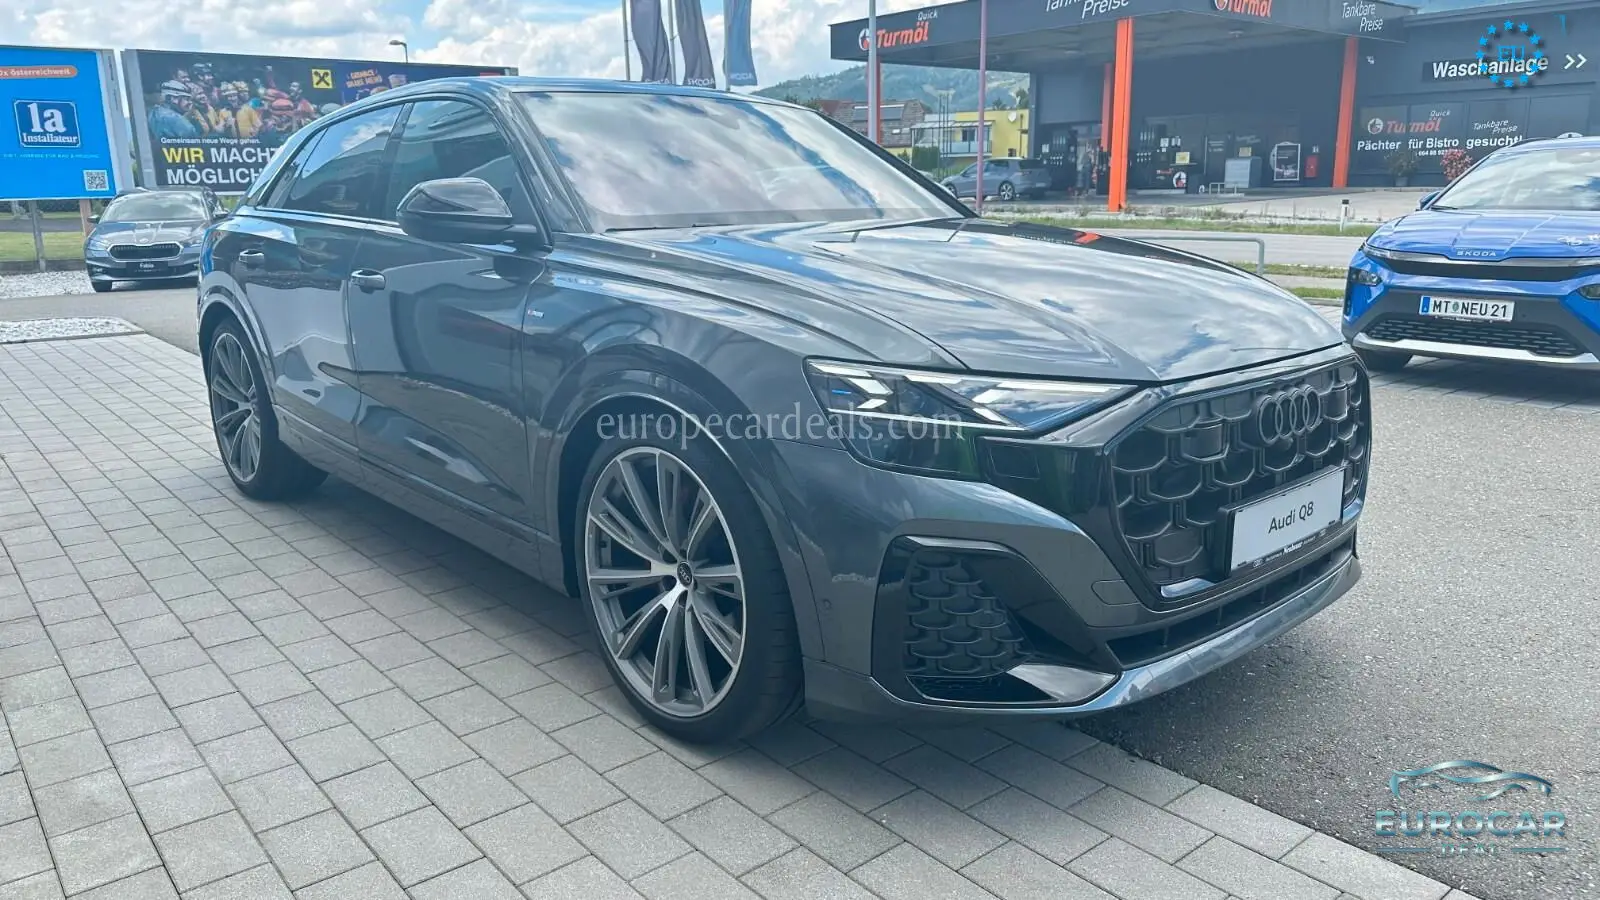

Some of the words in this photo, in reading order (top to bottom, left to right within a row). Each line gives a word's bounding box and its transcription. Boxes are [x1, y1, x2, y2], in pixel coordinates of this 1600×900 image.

[918, 9, 938, 20] Quick
[1342, 0, 1376, 19] Tankbare
[1359, 17, 1384, 32] Preise
[877, 21, 929, 48] Turmöl
[1432, 57, 1549, 78] Waschanlage
[28, 102, 67, 133] 1a
[1473, 119, 1509, 131] Tankbare
[23, 132, 78, 143] Installateur
[1491, 125, 1519, 135] Preise
[1357, 140, 1401, 151] Pächter
[1408, 139, 1424, 149] für
[1426, 137, 1459, 149] Bistro
[162, 147, 205, 163] WIR
[1432, 299, 1451, 313] MT
[1461, 301, 1488, 316] NEU
[1490, 304, 1508, 318] 21
[1268, 509, 1296, 534] Audi
[1298, 501, 1315, 521] Q8
